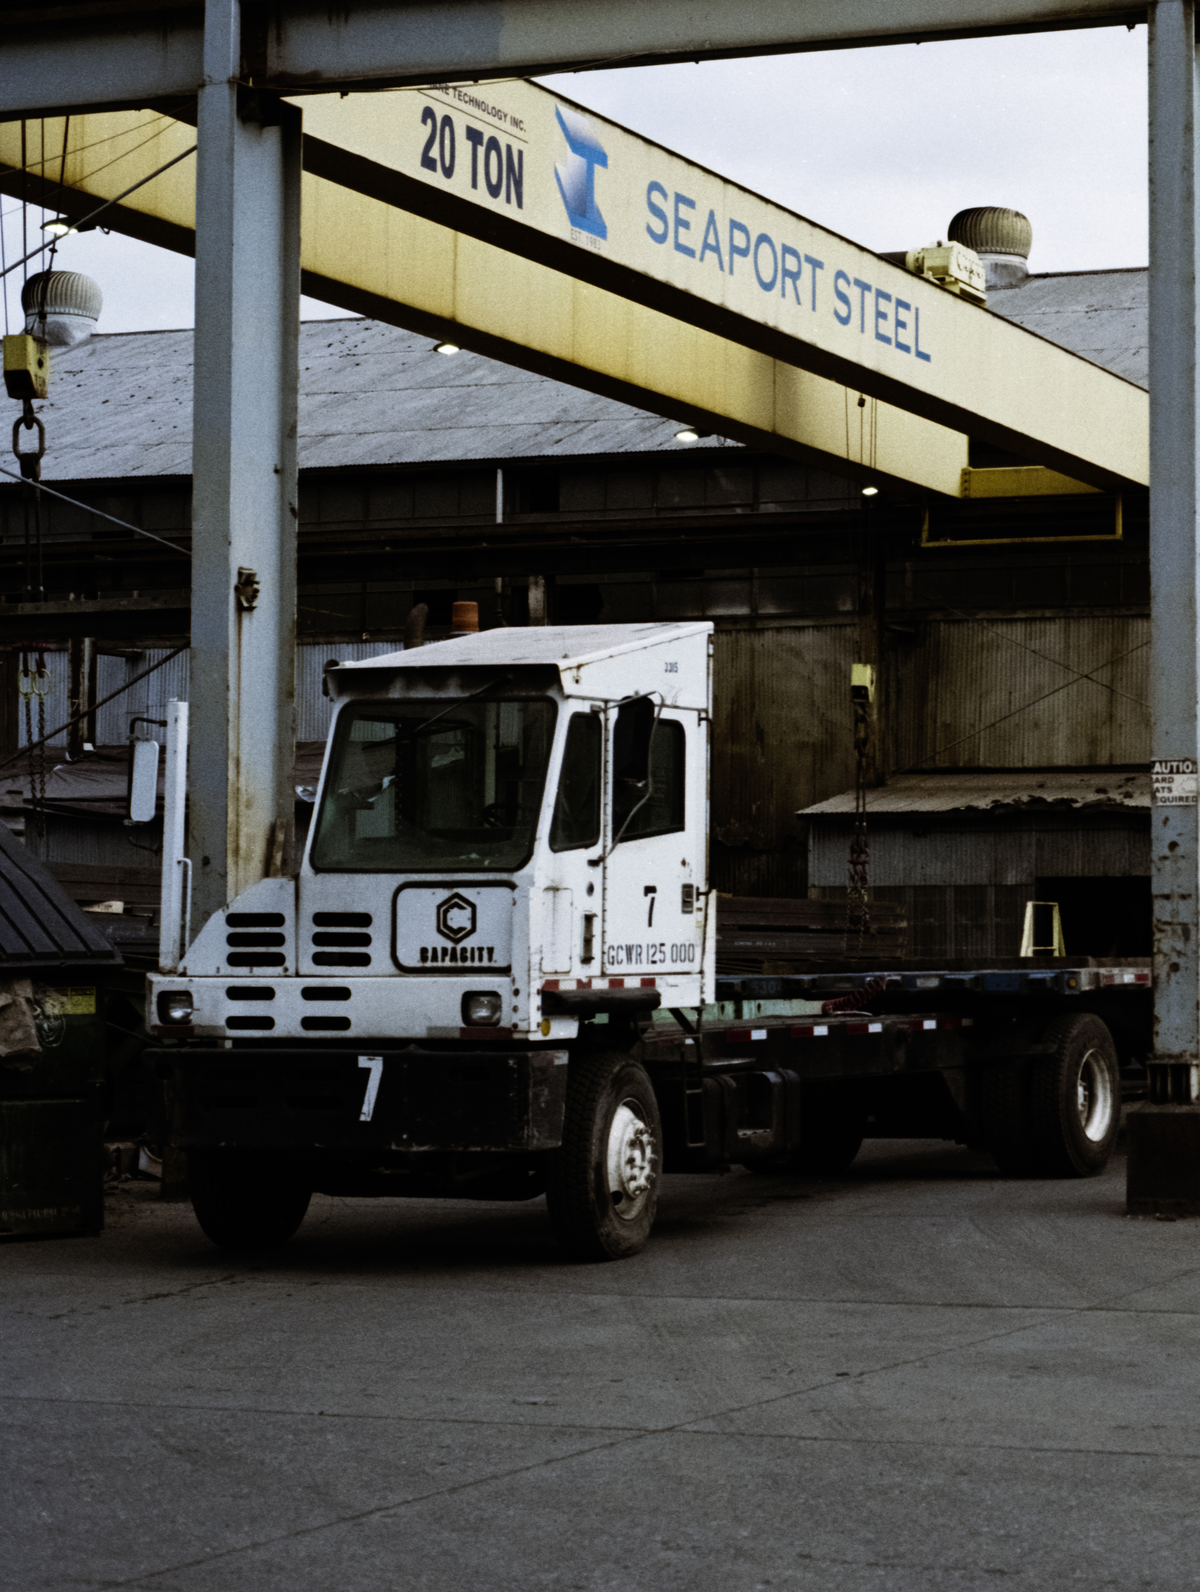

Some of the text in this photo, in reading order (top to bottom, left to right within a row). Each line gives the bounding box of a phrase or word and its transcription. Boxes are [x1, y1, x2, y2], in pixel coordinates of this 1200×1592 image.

[452, 87, 508, 122] TECHNOLOGY
[510, 115, 526, 132] INC.
[420, 105, 523, 210] 20 TON
[646, 180, 931, 363] SEAPORT STEEL
[1153, 776, 1174, 784] ARD
[1159, 795, 1197, 804] QUIRED
[643, 885, 657, 928] 7
[420, 946, 495, 964] CAPACITY
[607, 942, 695, 966] GCWR 125 000
[358, 1055, 384, 1122] 7
